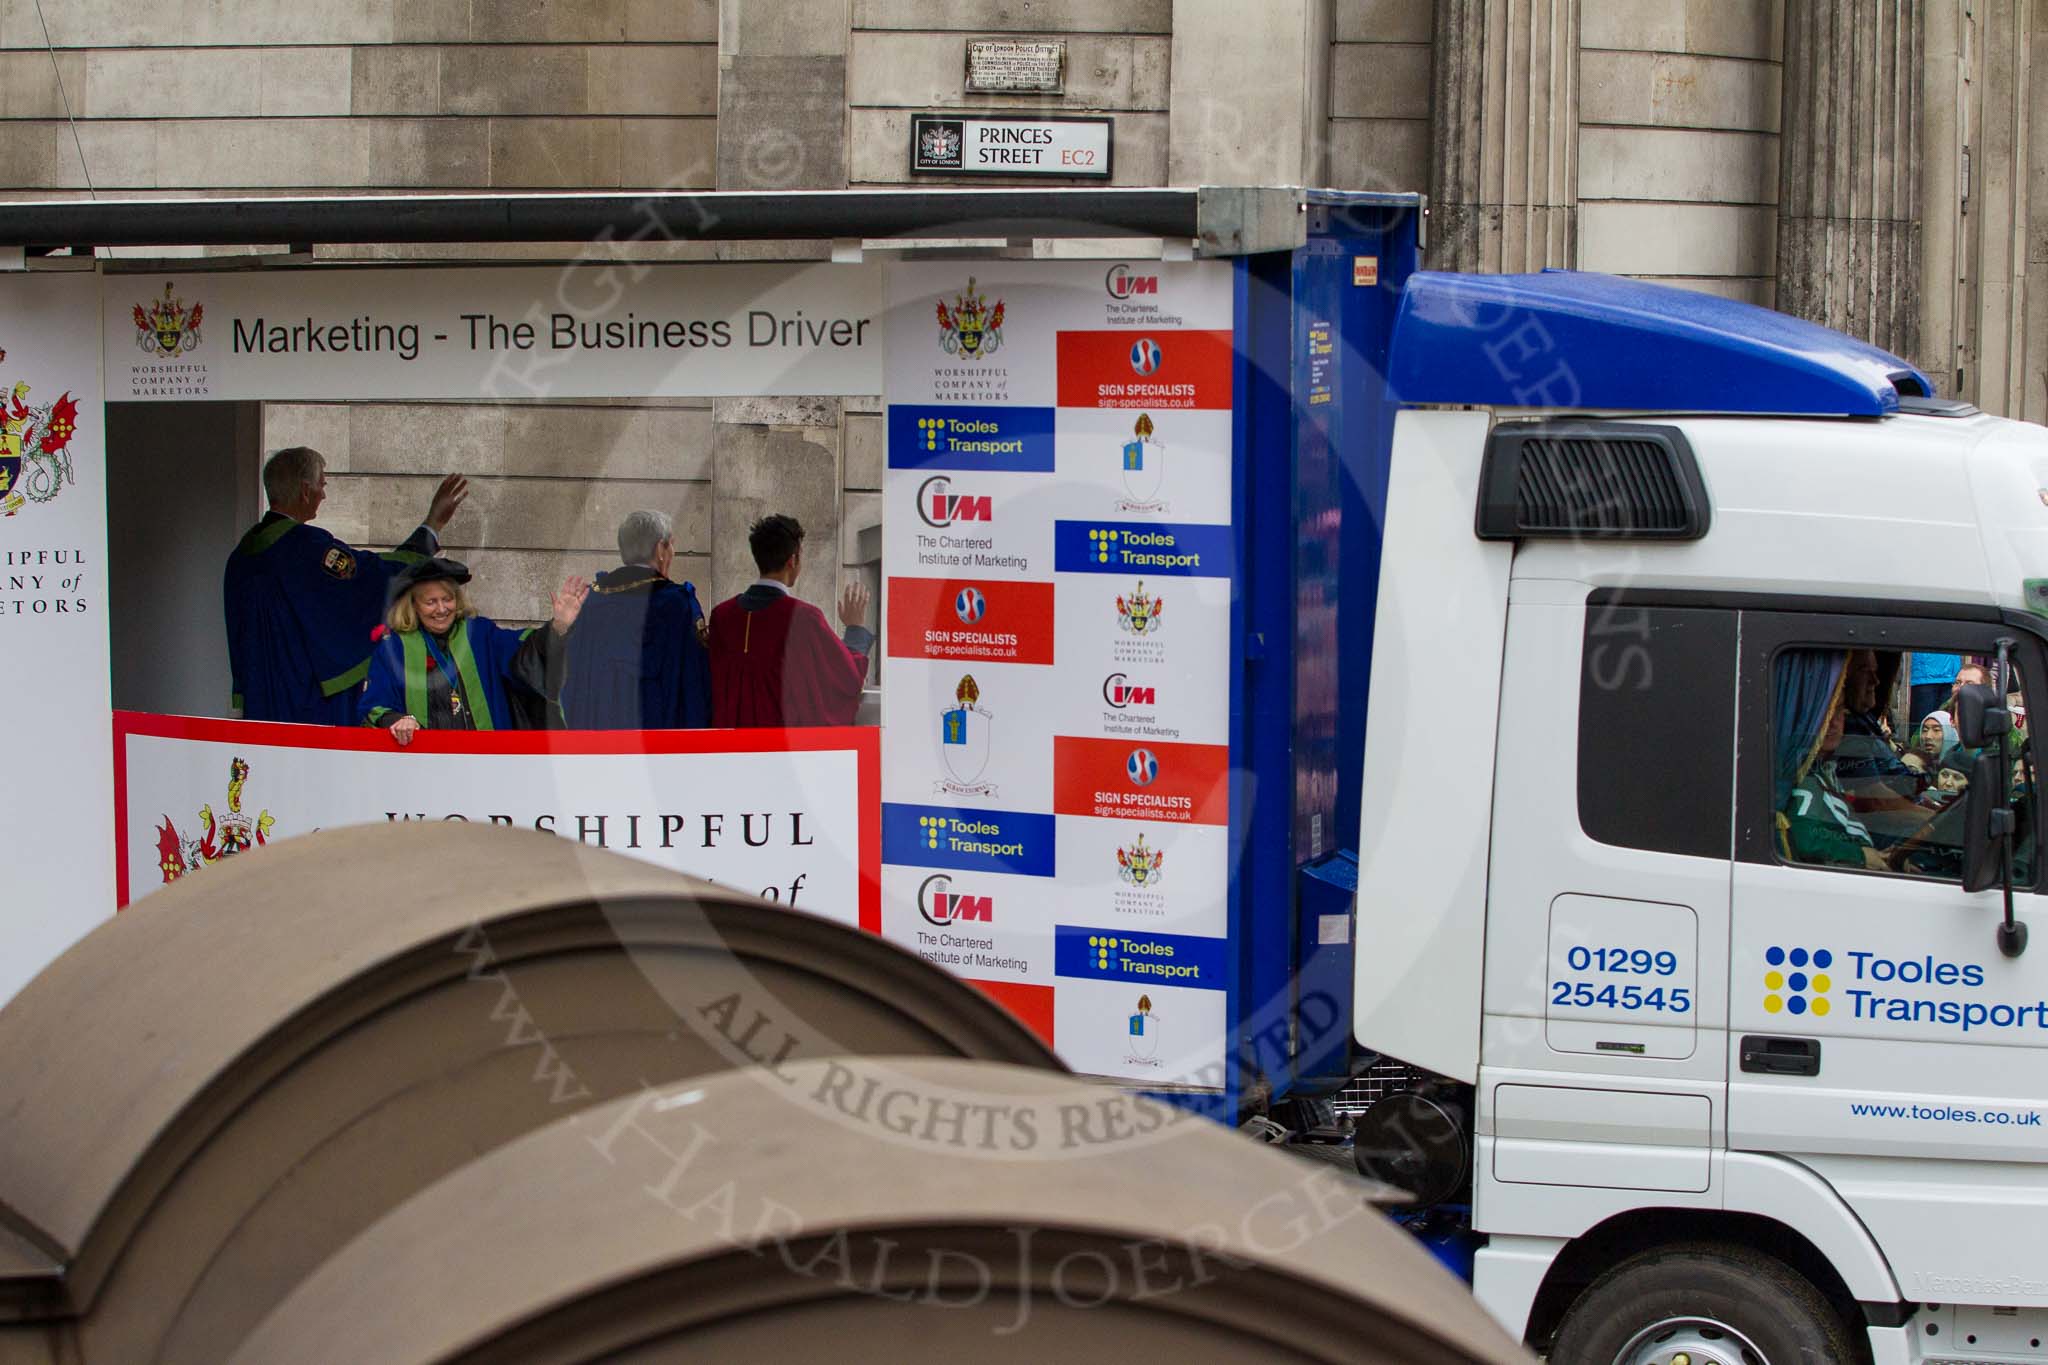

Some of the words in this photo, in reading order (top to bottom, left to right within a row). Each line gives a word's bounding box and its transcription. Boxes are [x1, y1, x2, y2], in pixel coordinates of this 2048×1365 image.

[979, 127, 1053, 144] PRINCES
[979, 148, 1044, 164] STREET
[1062, 150, 1095, 165] EC2
[1106, 304, 1120, 313] The
[1121, 304, 1158, 313] Chartered
[1107, 316, 1136, 324] Institute
[1137, 316, 1144, 324] of
[1145, 316, 1182, 326] Marketing
[233, 317, 420, 360] Marketing
[460, 314, 535, 350] The
[551, 312, 732, 349] Business
[748, 310, 870, 347] Driver
[132, 365, 208, 374] WORSHIPFUL
[934, 368, 1009, 377] WORSHIPFUL
[132, 377, 191, 385] COMPANY
[196, 376, 206, 385] of
[934, 380, 992, 389] COMPANY
[997, 380, 1007, 389] of
[132, 387, 209, 396] MARKETORS
[935, 392, 1009, 401] MARKETORS
[1098, 384, 1125, 396] SIGN
[1127, 384, 1196, 397] SPECIALISTS
[1098, 398, 1196, 409] sign-specialists.co.uk
[947, 418, 999, 433] Tooles
[947, 438, 1023, 455] Transport
[917, 536, 937, 548] The
[940, 536, 992, 550] Chartered
[1121, 531, 1175, 546] Tooles
[918, 553, 959, 566] Institute
[962, 554, 974, 566] of
[975, 554, 1028, 571] Marketing
[1121, 550, 1200, 568] Transport
[0, 574, 44, 590] NY
[62, 573, 83, 593] of
[925, 630, 950, 643] SIGN
[952, 631, 1017, 645] SPECIALISTS
[925, 643, 1017, 657] sign-specialists.co.uk
[1103, 712, 1118, 722] The
[1119, 713, 1156, 724] Chartered
[1104, 724, 1132, 734] Institute
[1133, 725, 1142, 735] of
[1142, 725, 1180, 738] Marketing
[1095, 791, 1120, 804] SIGN
[1122, 792, 1192, 809] SPECIALISTS
[1094, 804, 1192, 820] sign-specialists.co.uk
[385, 811, 815, 849] SHIPFUL
[949, 818, 1000, 835] Tooles
[949, 837, 1024, 857] Transport
[917, 932, 937, 946] The
[940, 933, 993, 950] Chartered
[1120, 939, 1175, 957] Tooles
[918, 949, 960, 964] Institute
[962, 952, 975, 966] of
[975, 953, 1028, 973] Marketing
[1120, 958, 1200, 979] Transport
[1567, 945, 1678, 976] 01299
[1847, 950, 1985, 987] Tooles
[1550, 981, 1691, 1014] 254545
[1845, 989, 2048, 1032] Transport
[1850, 1103, 2042, 1126] www.tooles.co.uk
